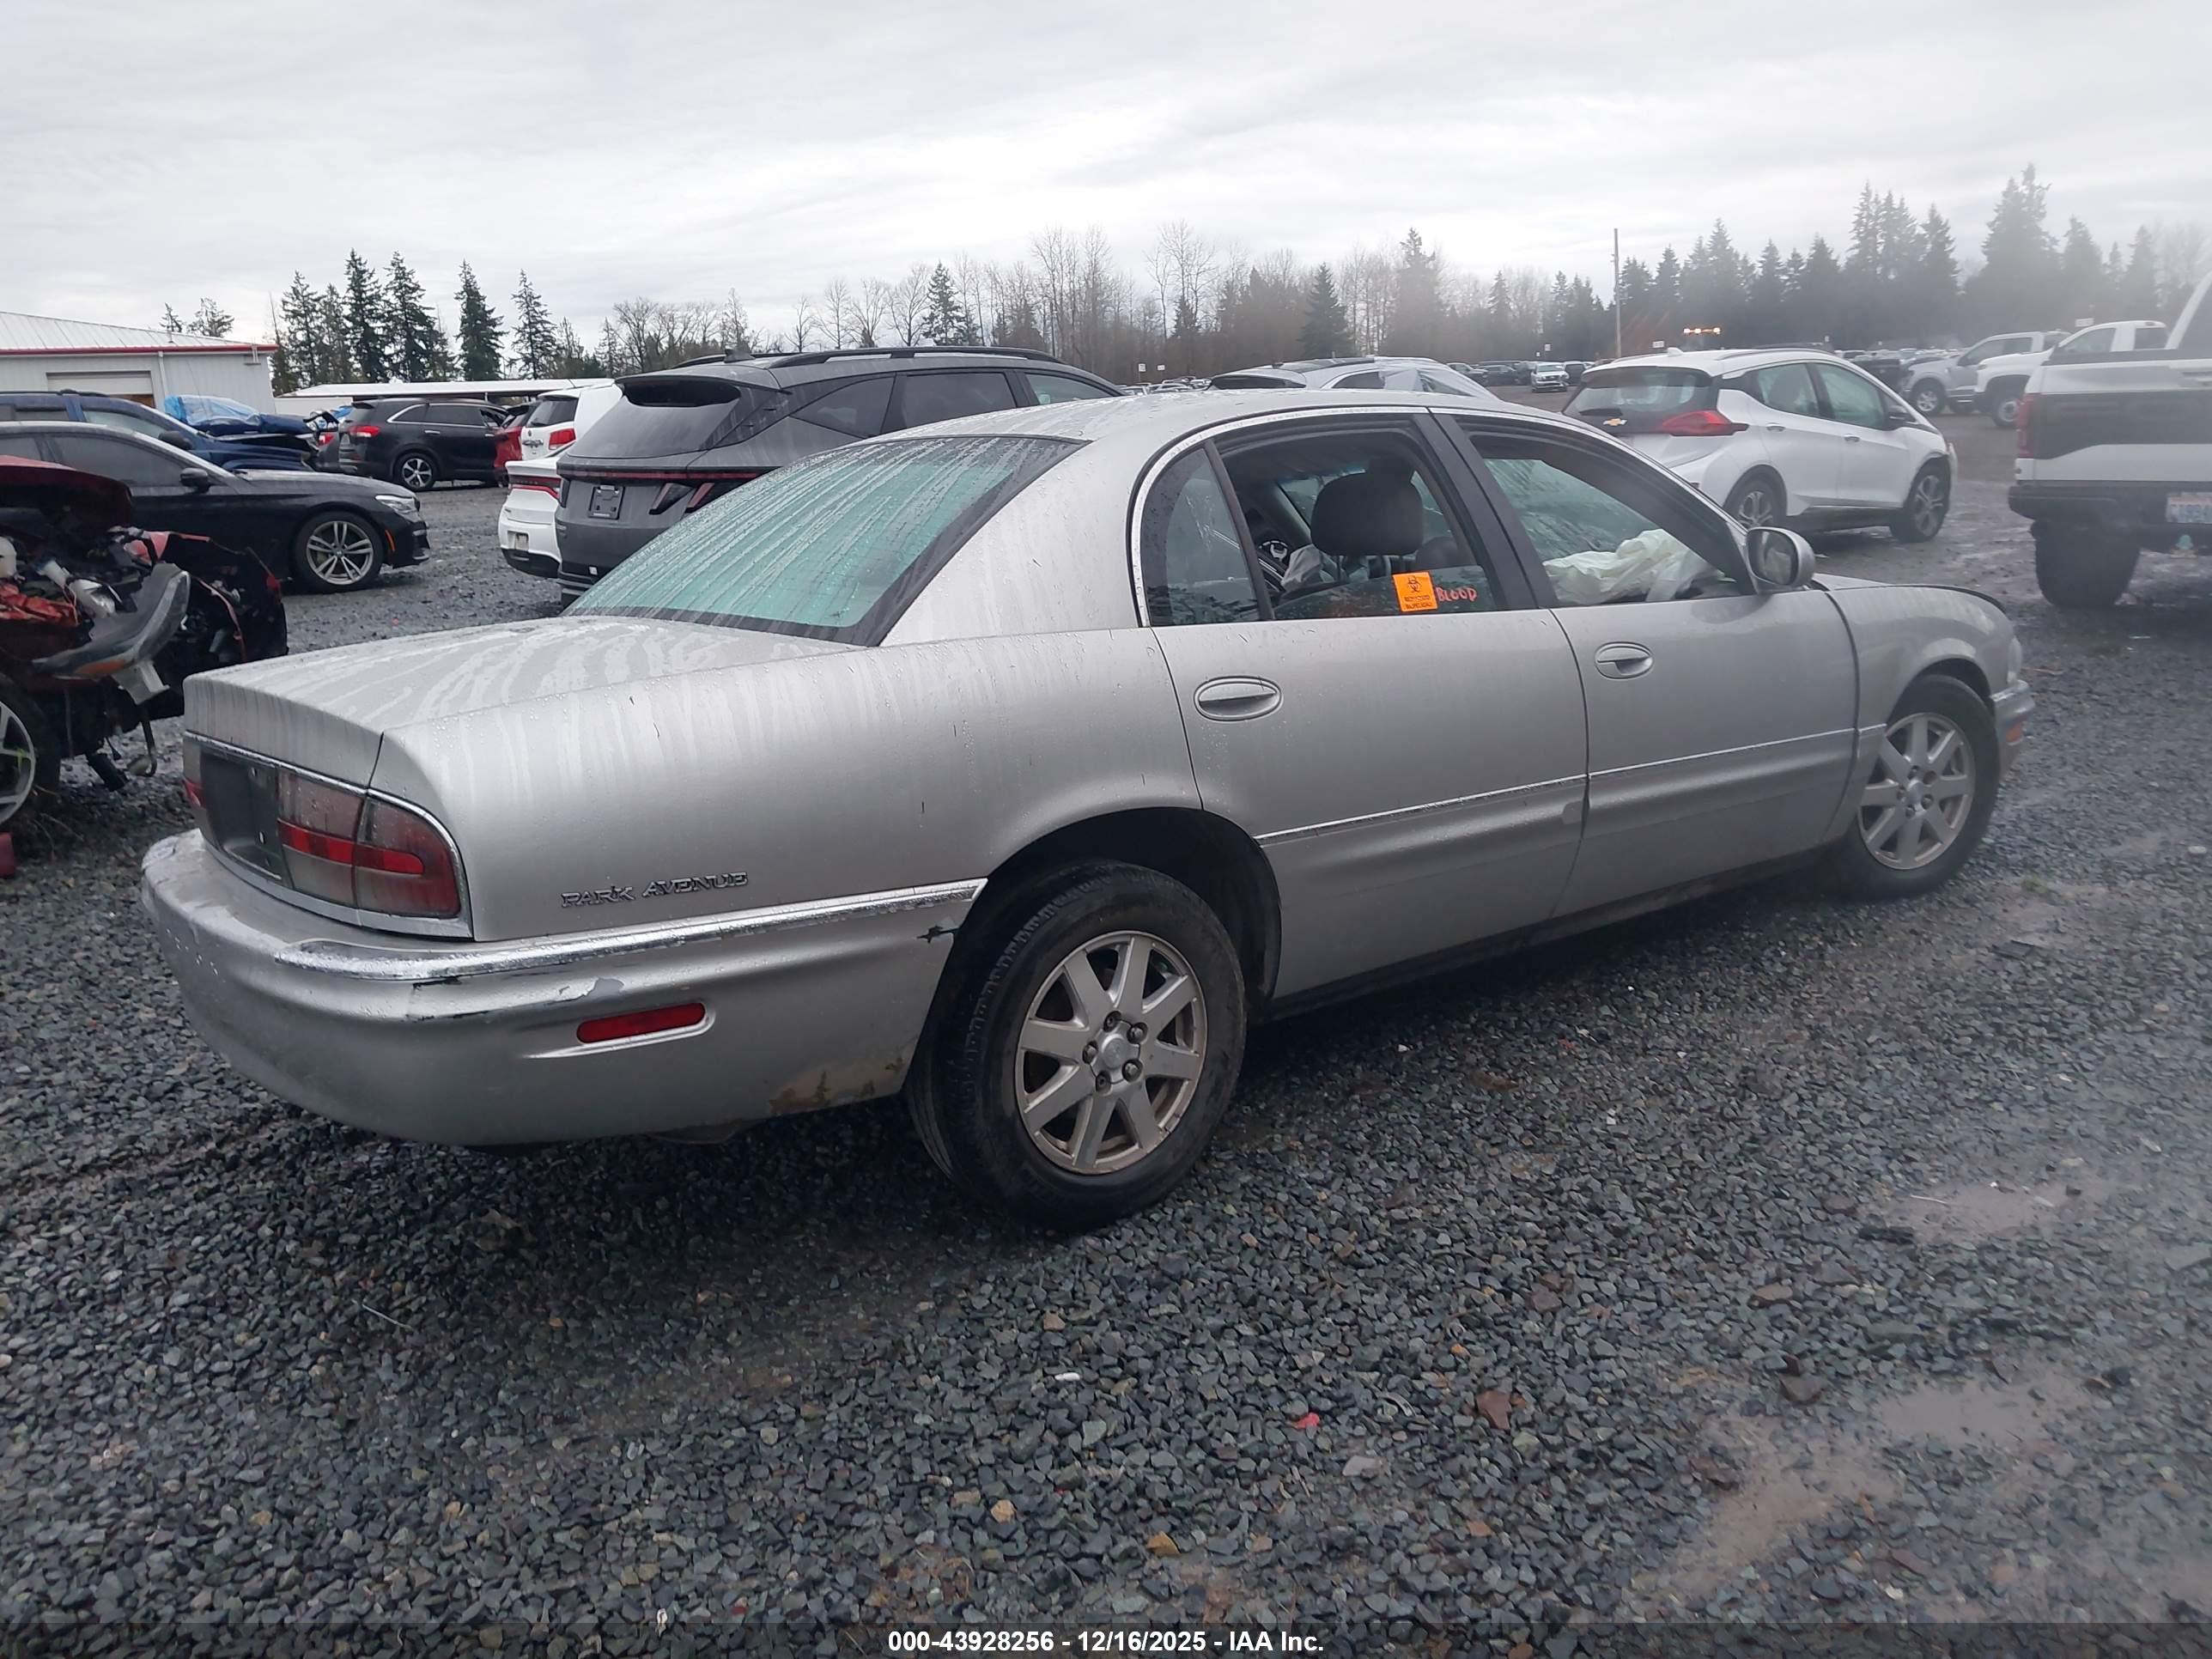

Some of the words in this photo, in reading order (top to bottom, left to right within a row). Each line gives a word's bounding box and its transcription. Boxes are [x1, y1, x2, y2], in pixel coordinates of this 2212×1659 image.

[1435, 586, 1477, 602] BLOOD
[561, 886, 635, 908] PARK
[642, 872, 748, 897] AVENUE
